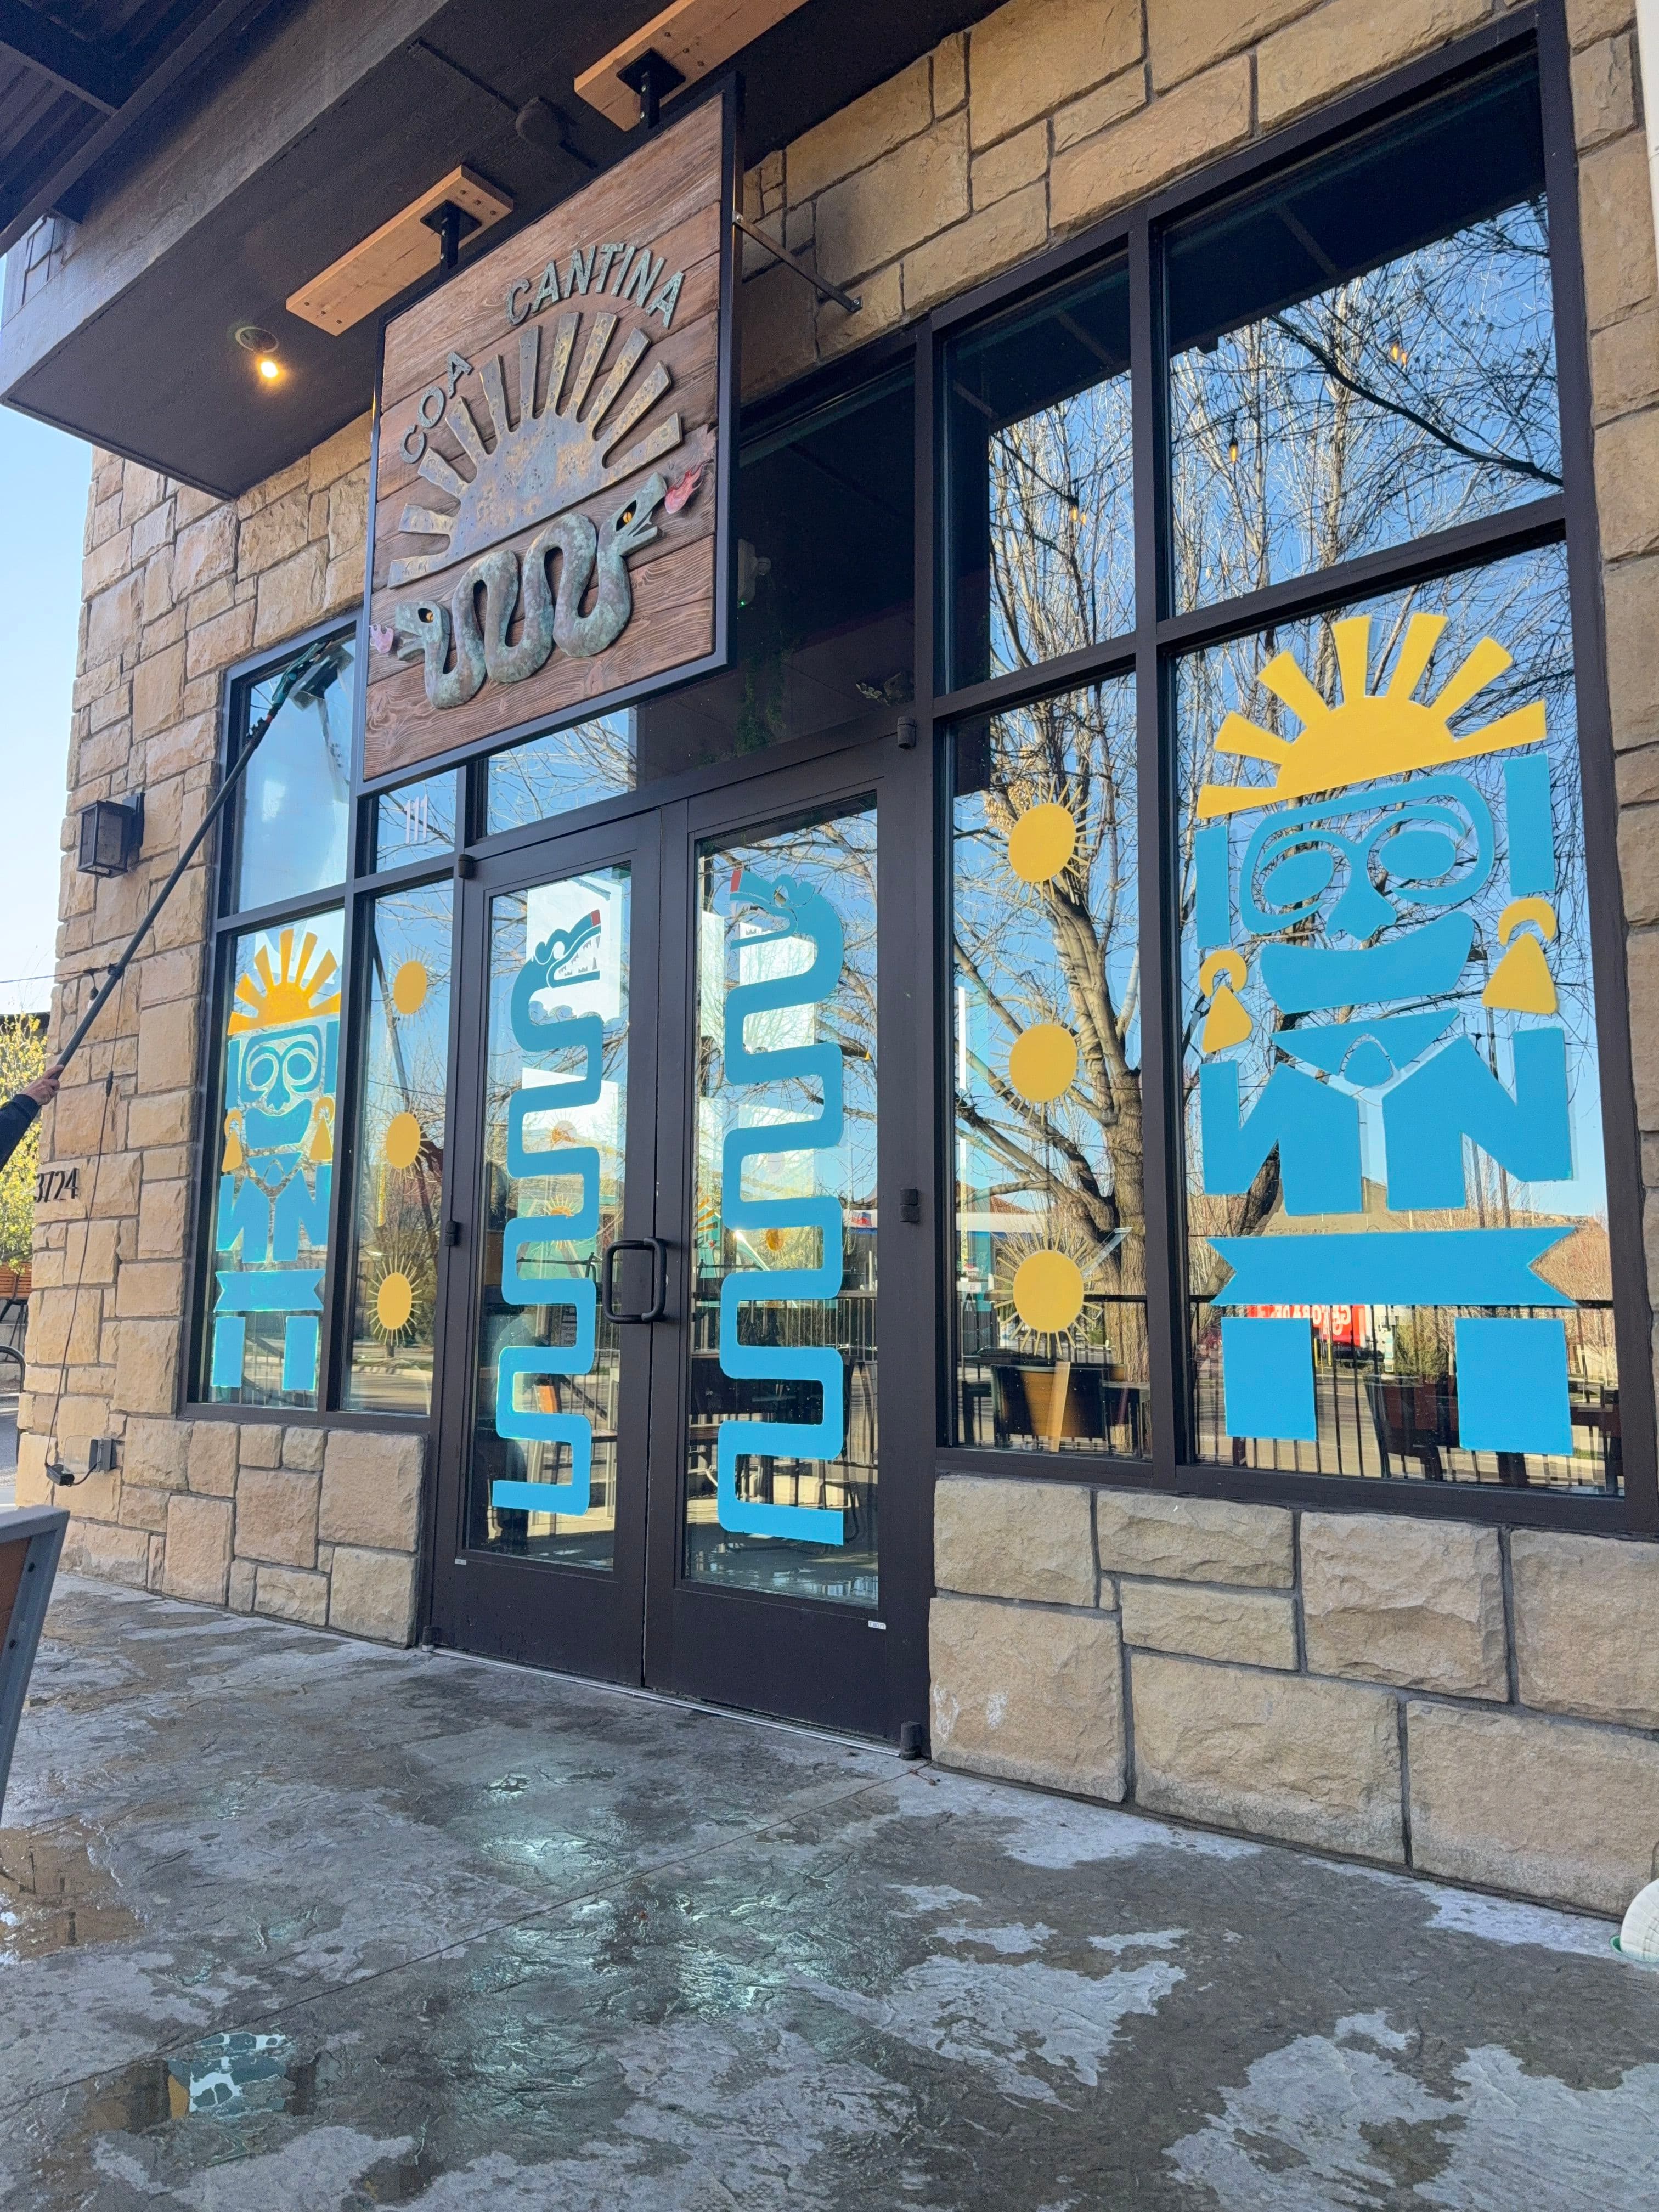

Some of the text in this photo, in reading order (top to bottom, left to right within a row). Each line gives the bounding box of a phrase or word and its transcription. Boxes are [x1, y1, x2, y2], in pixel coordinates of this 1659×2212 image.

[400, 243, 684, 464] COA CANTINA
[404, 794, 428, 844] 111
